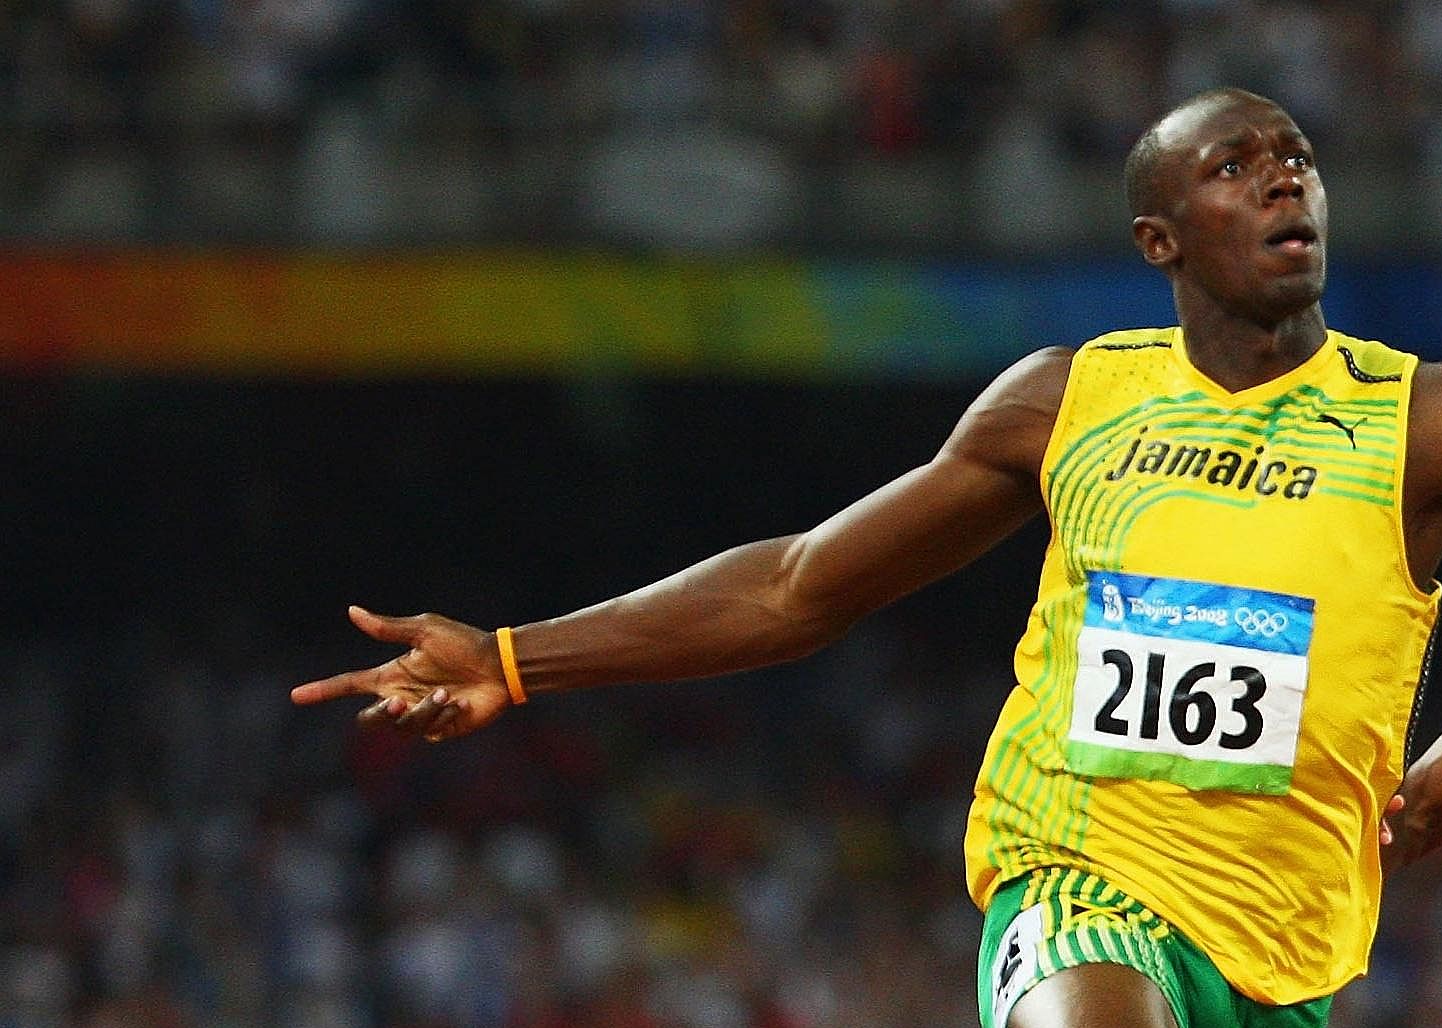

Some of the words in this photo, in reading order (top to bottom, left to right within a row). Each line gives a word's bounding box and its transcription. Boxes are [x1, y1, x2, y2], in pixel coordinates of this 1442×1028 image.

[1107, 425, 1318, 500] jamaica
[1128, 597, 1181, 625] Beijing
[1183, 605, 1228, 627] 2008
[1093, 648, 1267, 750] 2163
